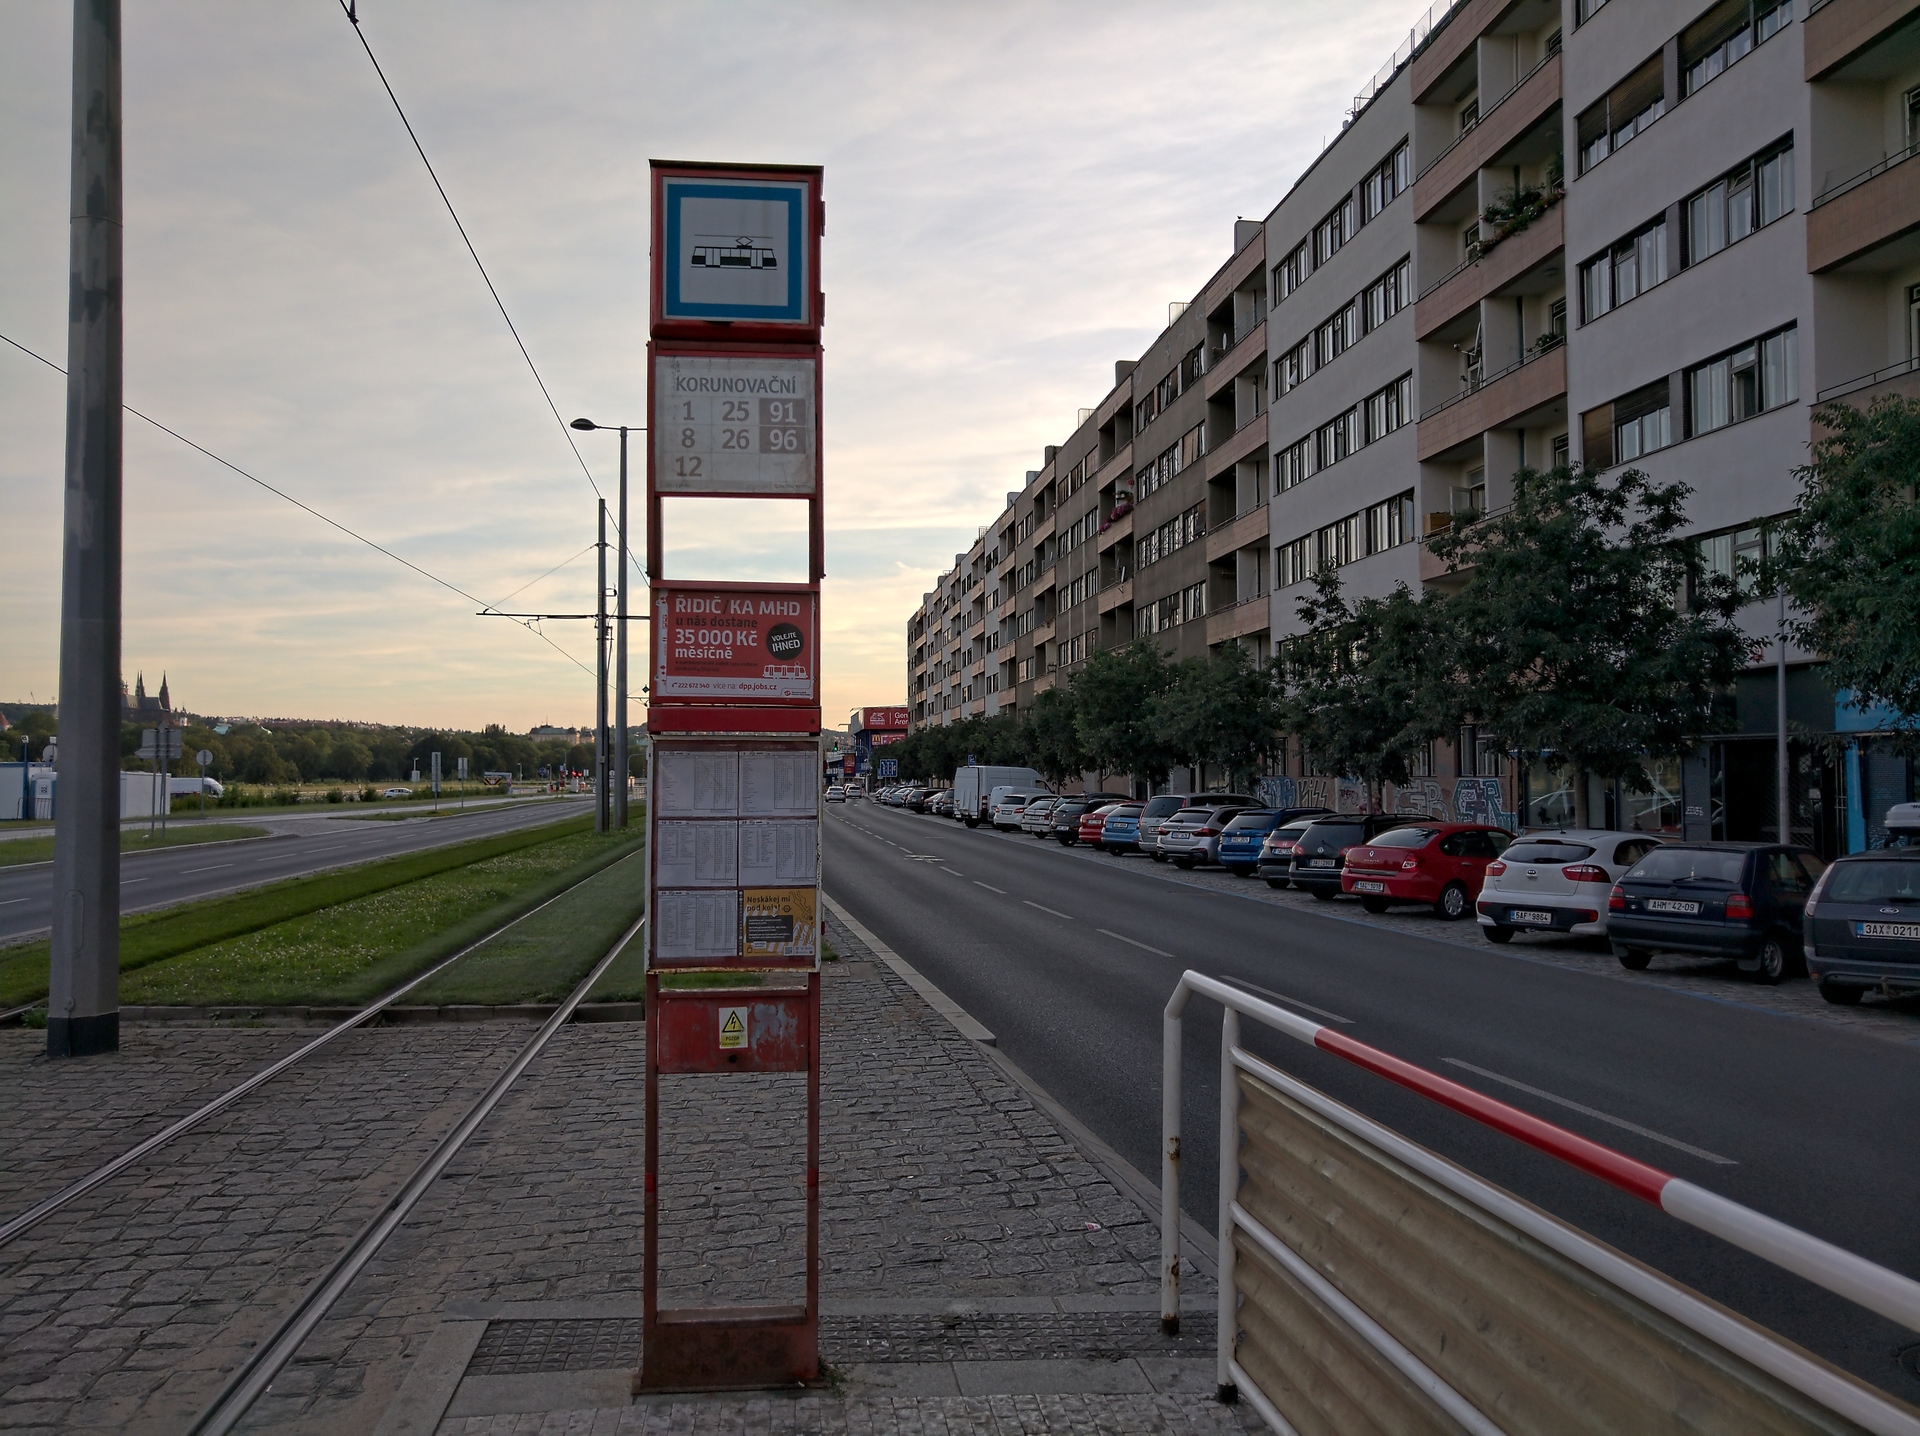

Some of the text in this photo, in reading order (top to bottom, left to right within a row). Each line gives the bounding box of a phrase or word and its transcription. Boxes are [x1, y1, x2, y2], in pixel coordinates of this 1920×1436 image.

[675, 376, 796, 394] KORUNOVAČNÍ
[683, 401, 797, 423] 1 25 91
[681, 428, 798, 451] 8 26 96
[675, 456, 702, 477] 12
[759, 600, 801, 616] MHD
[676, 615, 758, 628] u nás dostane
[736, 630, 758, 647] Kč
[771, 631, 798, 642] VOLEJTE
[675, 646, 733, 659] měsíčně
[771, 639, 801, 653] IHNED
[738, 683, 777, 692] dpp.jobs.cz
[747, 895, 780, 904] Neskákej
[1651, 900, 1695, 912] AHM 42-09
[746, 904, 761, 913] pod
[1865, 924, 1919, 936] 3AX 0211
